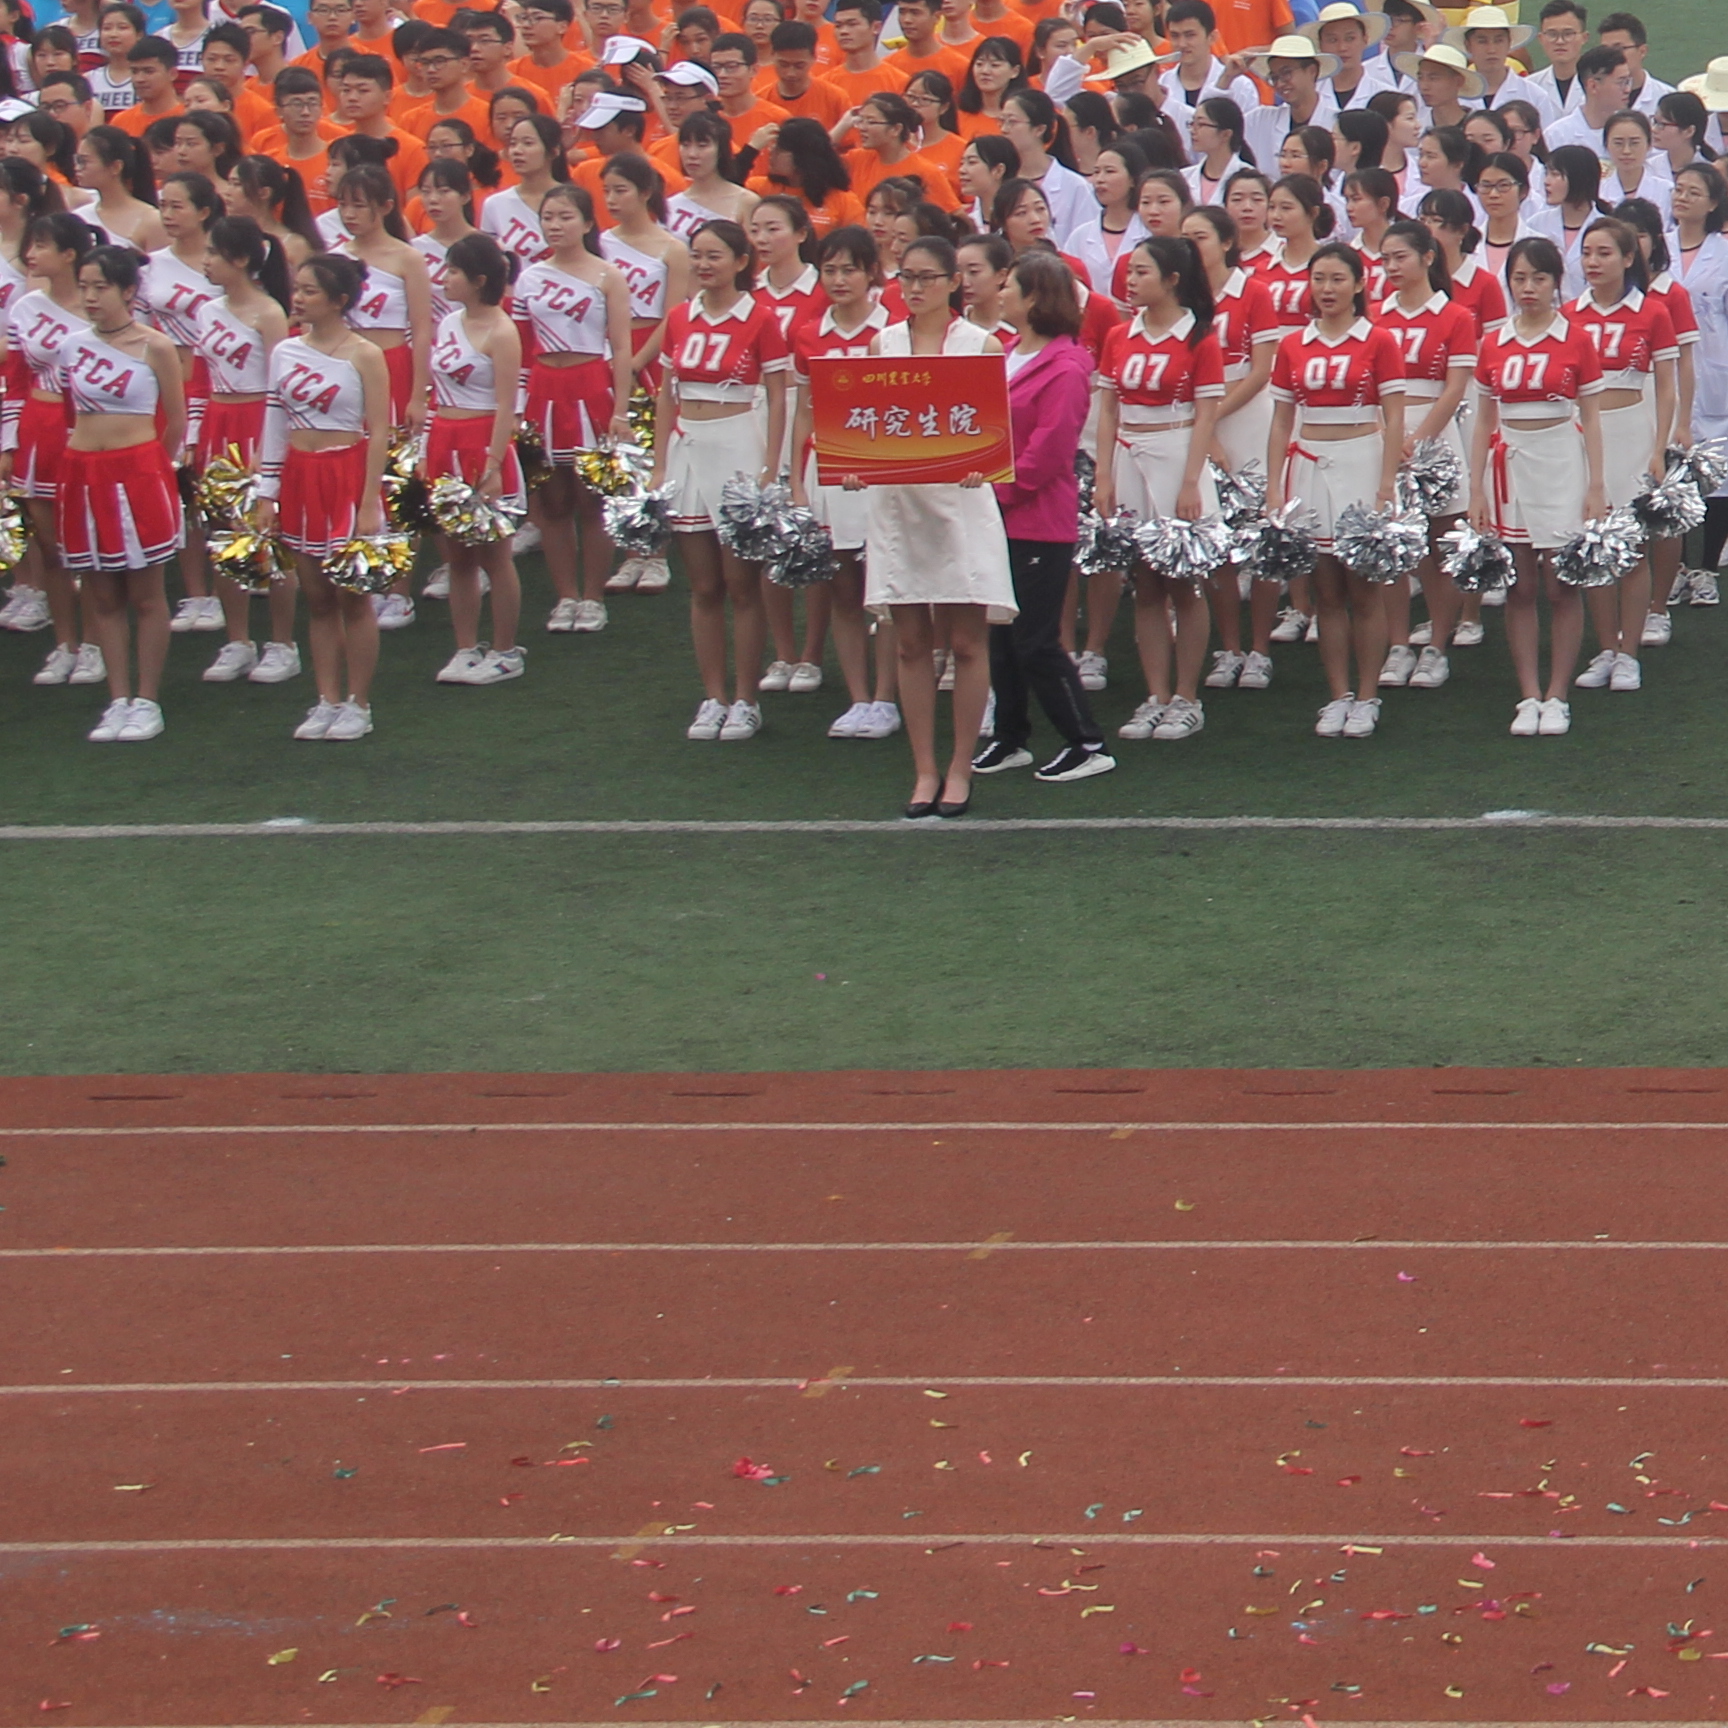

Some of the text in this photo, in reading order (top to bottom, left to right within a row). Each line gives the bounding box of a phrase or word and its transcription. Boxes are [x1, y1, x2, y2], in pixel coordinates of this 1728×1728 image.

[533, 279, 593, 324] TCA
[28, 312, 69, 355] TC
[201, 320, 254, 371] TCA
[680, 332, 731, 372] 07
[68, 346, 135, 399] TCA
[281, 363, 342, 414] TCA
[1121, 352, 1171, 391] 07
[1304, 354, 1351, 390] 07
[1501, 353, 1549, 390] 07
[844, 403, 982, 440] 研究生院
